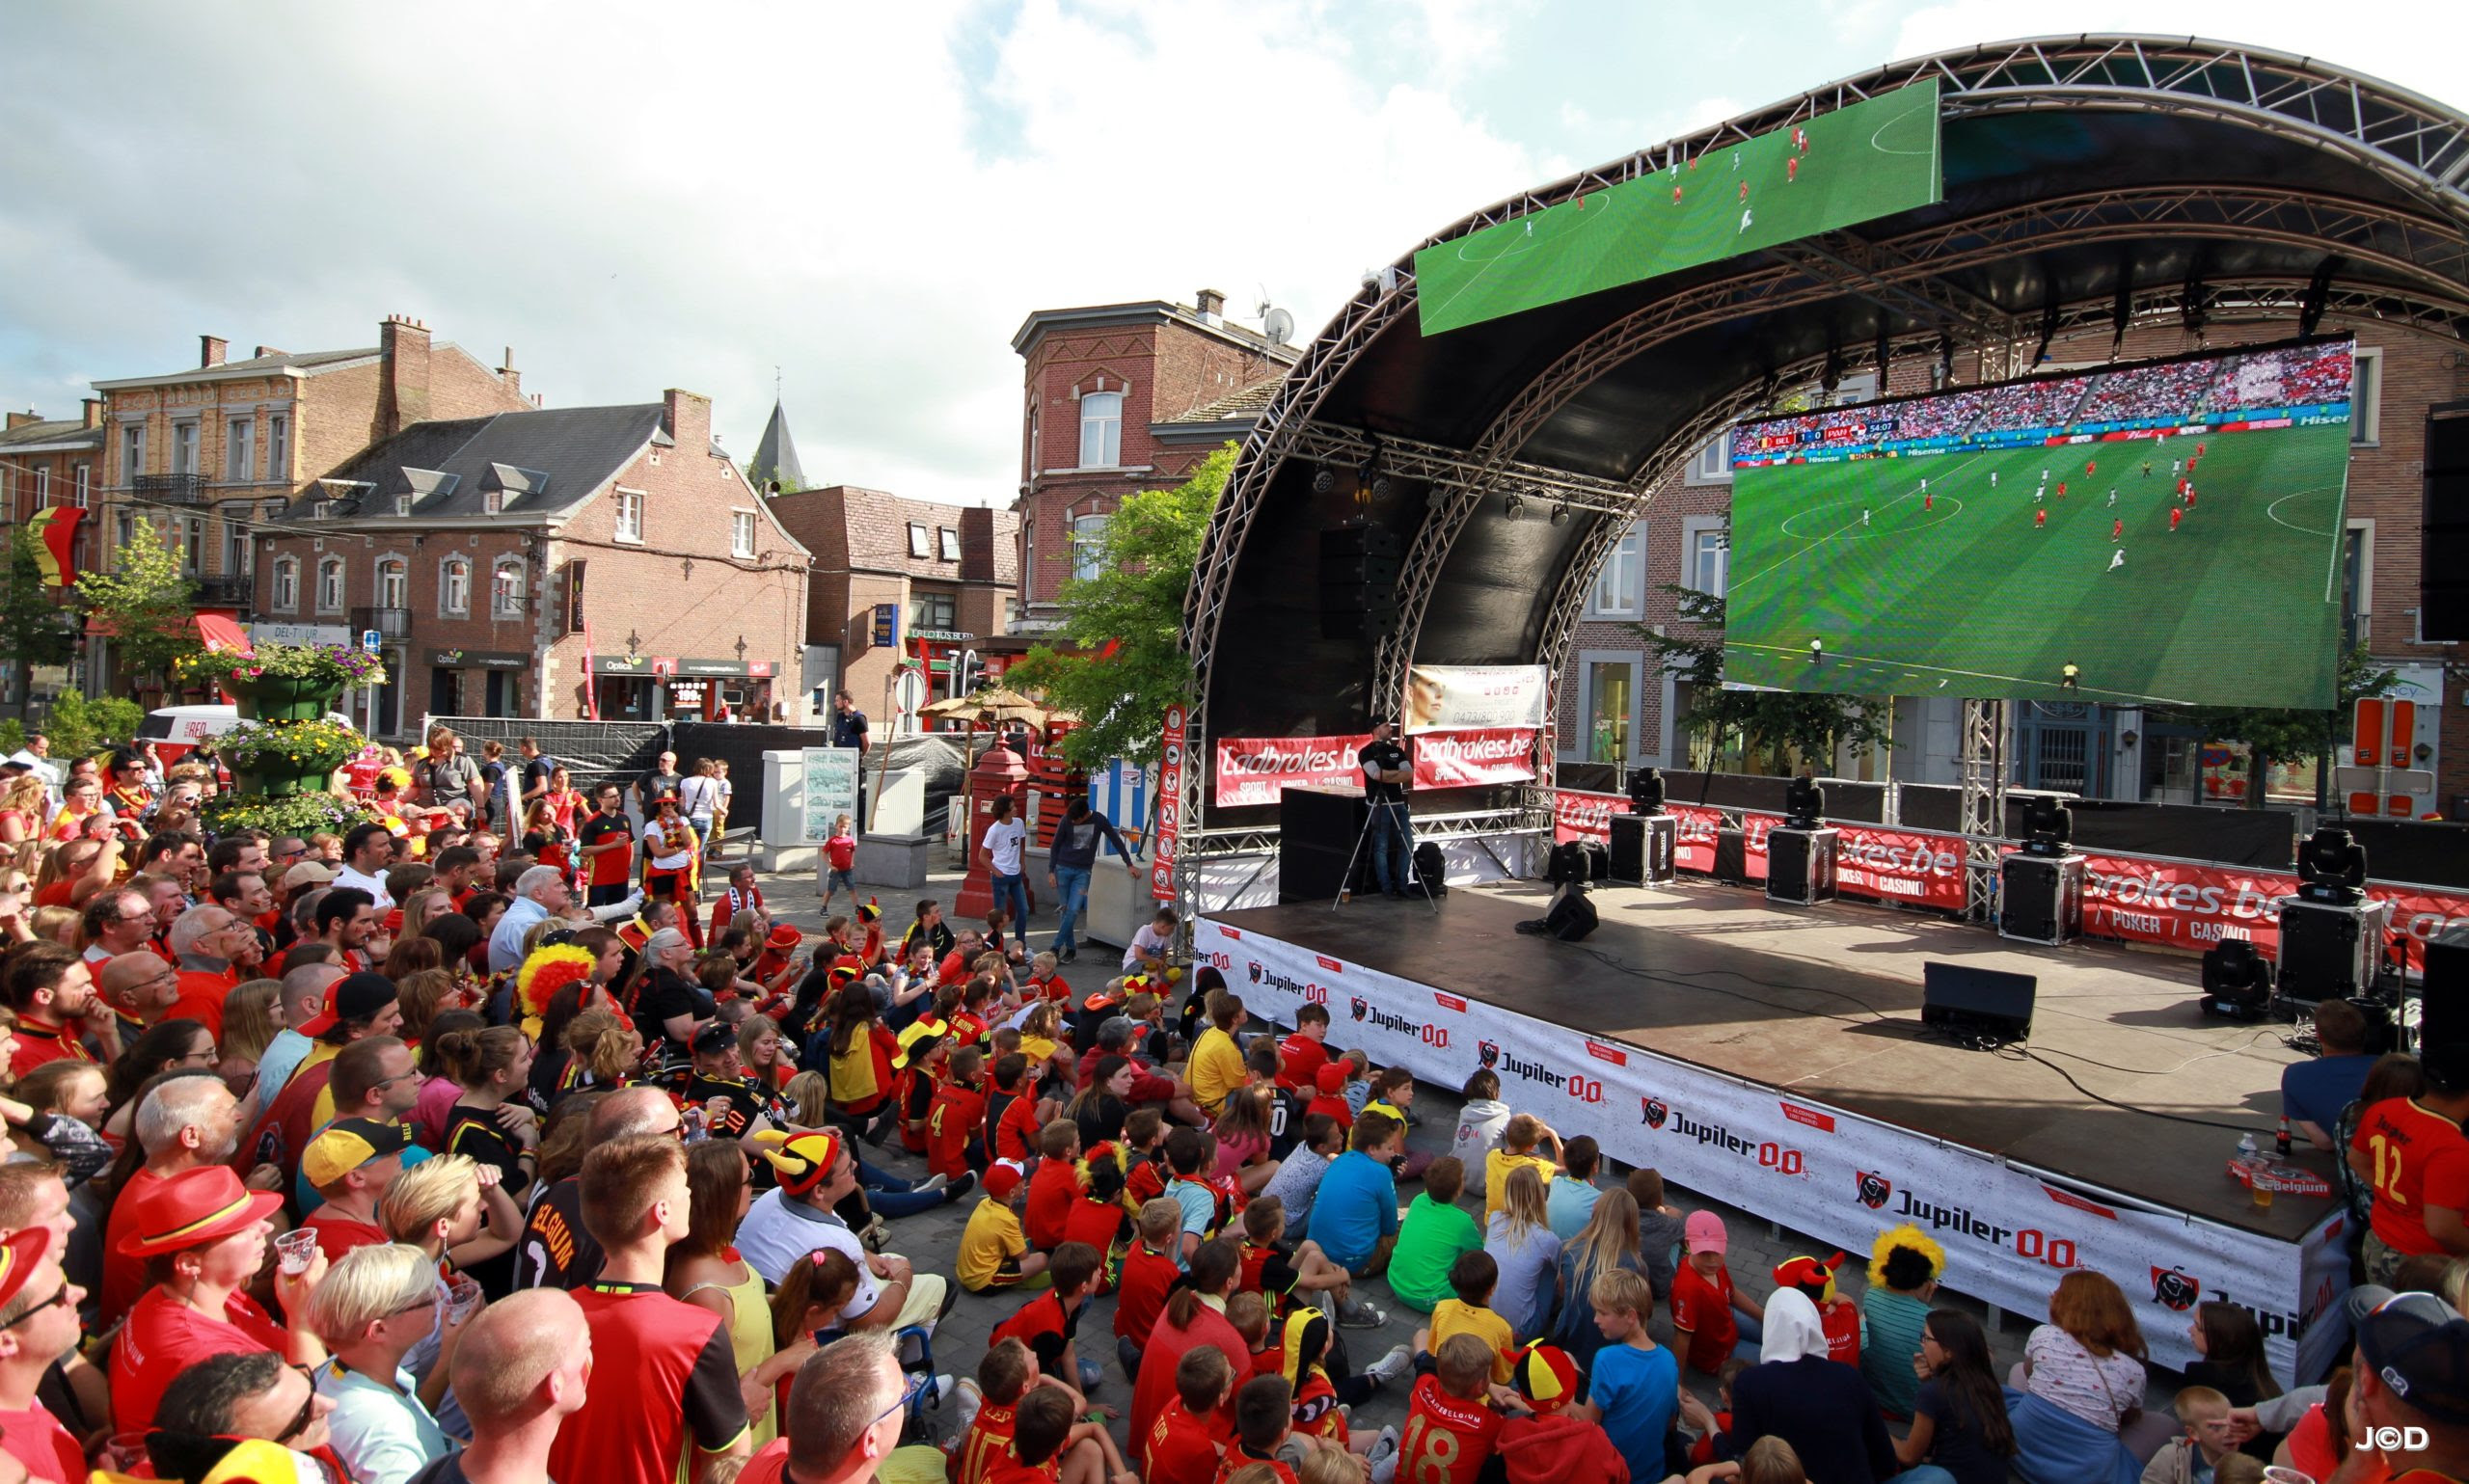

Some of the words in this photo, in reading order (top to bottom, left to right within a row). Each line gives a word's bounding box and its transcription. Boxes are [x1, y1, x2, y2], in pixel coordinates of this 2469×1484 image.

[1776, 436, 1790, 445] BEL
[1801, 432, 1805, 442] 1
[1815, 431, 1822, 441] 0
[1828, 429, 1848, 439] PAN
[1869, 422, 1893, 433] 54:07
[1808, 455, 1840, 465] Hisense
[1907, 447, 1946, 457] Hisense
[923, 630, 952, 640] LOTUS
[437, 654, 458, 664] Optica
[606, 660, 634, 672] Optica
[188, 721, 207, 738] RED
[1222, 742, 1363, 776] Ladbrokes.b
[1420, 733, 1531, 763] Ladbrokes.be
[1239, 780, 1267, 796] SPORT
[1880, 876, 1925, 897] CASINO
[2112, 909, 2161, 934] POKER
[2189, 921, 2251, 942] CASINO
[1262, 969, 1305, 995] Jupiler
[1368, 1007, 1420, 1037] Jupiler
[1500, 1052, 1567, 1089] Jupiler
[725, 1110, 746, 1135] 10
[931, 1103, 946, 1137] 4
[1669, 1111, 1756, 1157] Jupiler
[2369, 1133, 2407, 1205] 12
[2272, 1181, 2328, 1194] Belgium
[1892, 1188, 2012, 1246] Jupiler
[1400, 1413, 1459, 1484] 18
